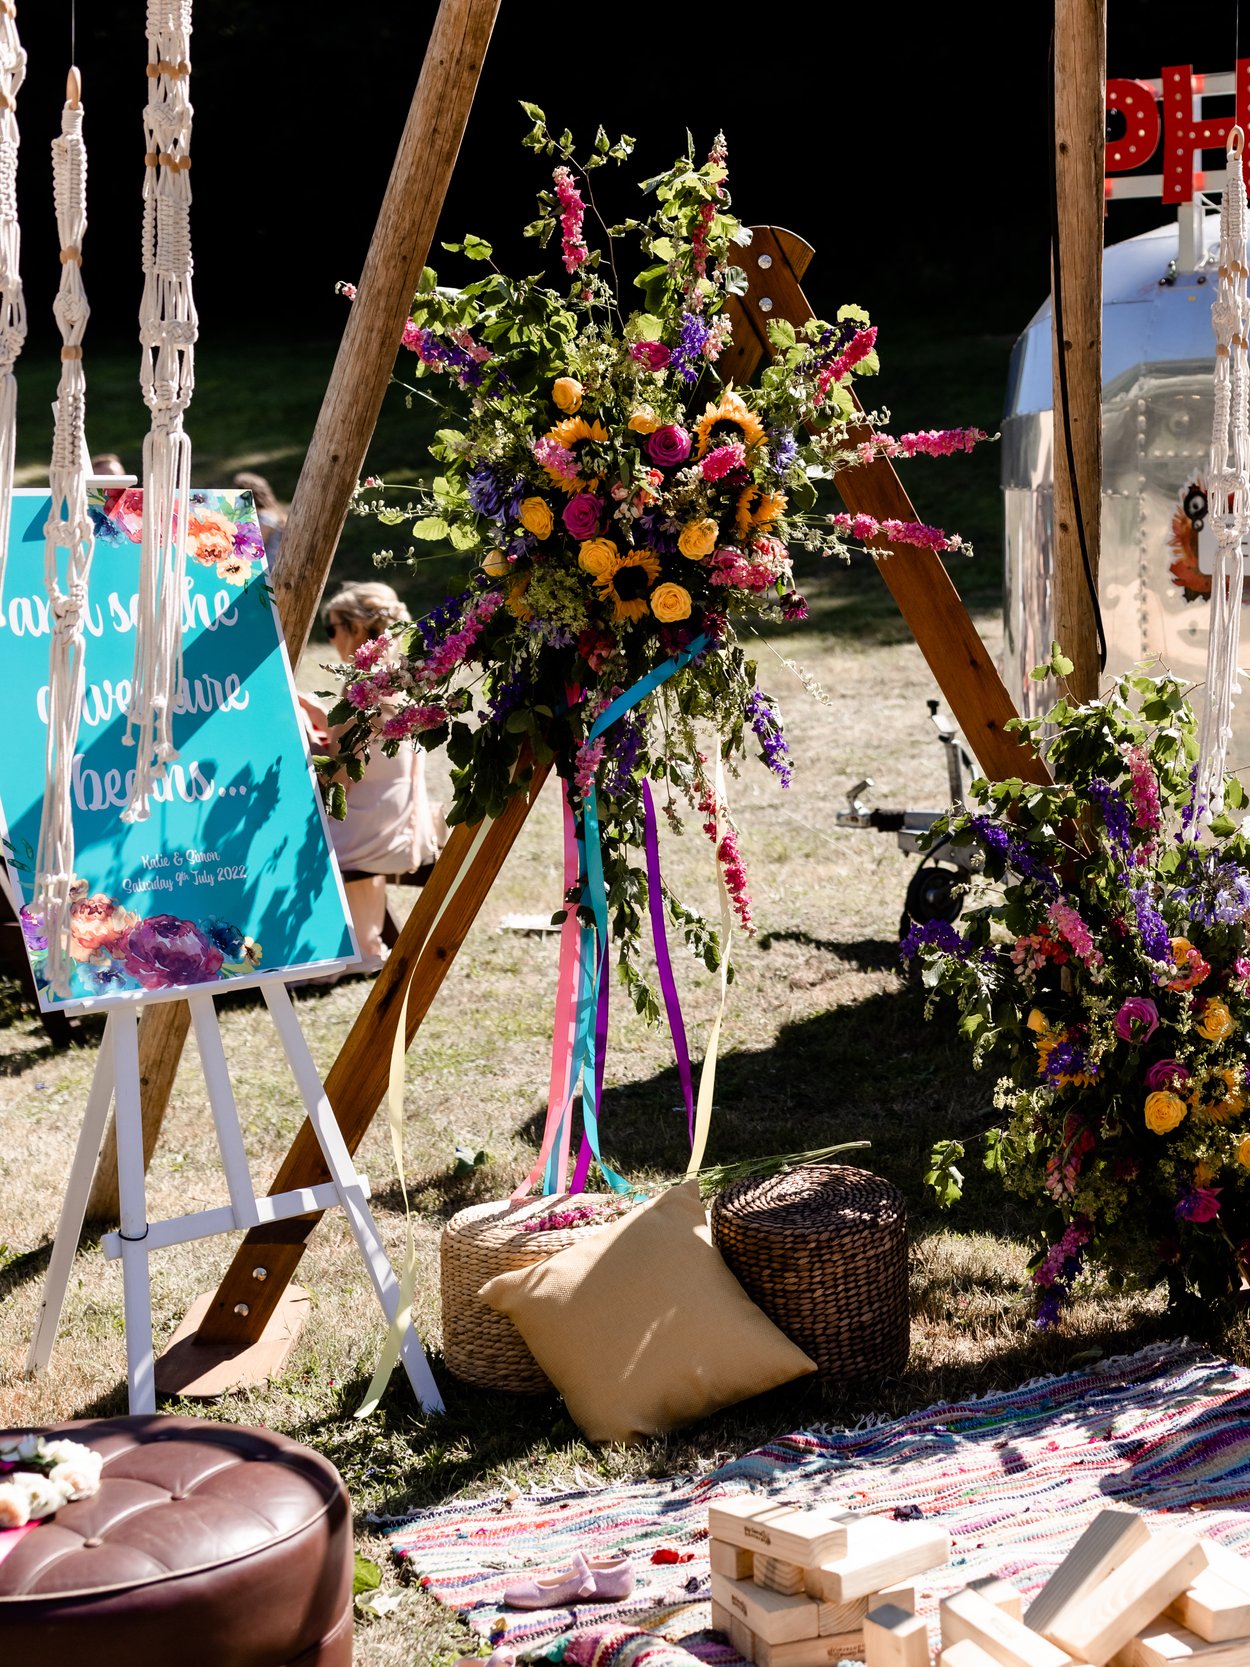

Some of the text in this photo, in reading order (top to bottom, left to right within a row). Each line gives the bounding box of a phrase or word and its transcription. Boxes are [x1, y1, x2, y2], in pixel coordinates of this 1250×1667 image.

[141, 849, 220, 870] Katie & Simon
[122, 876, 173, 894] Saturday
[190, 869, 214, 886] July
[217, 864, 247, 881] 2022
